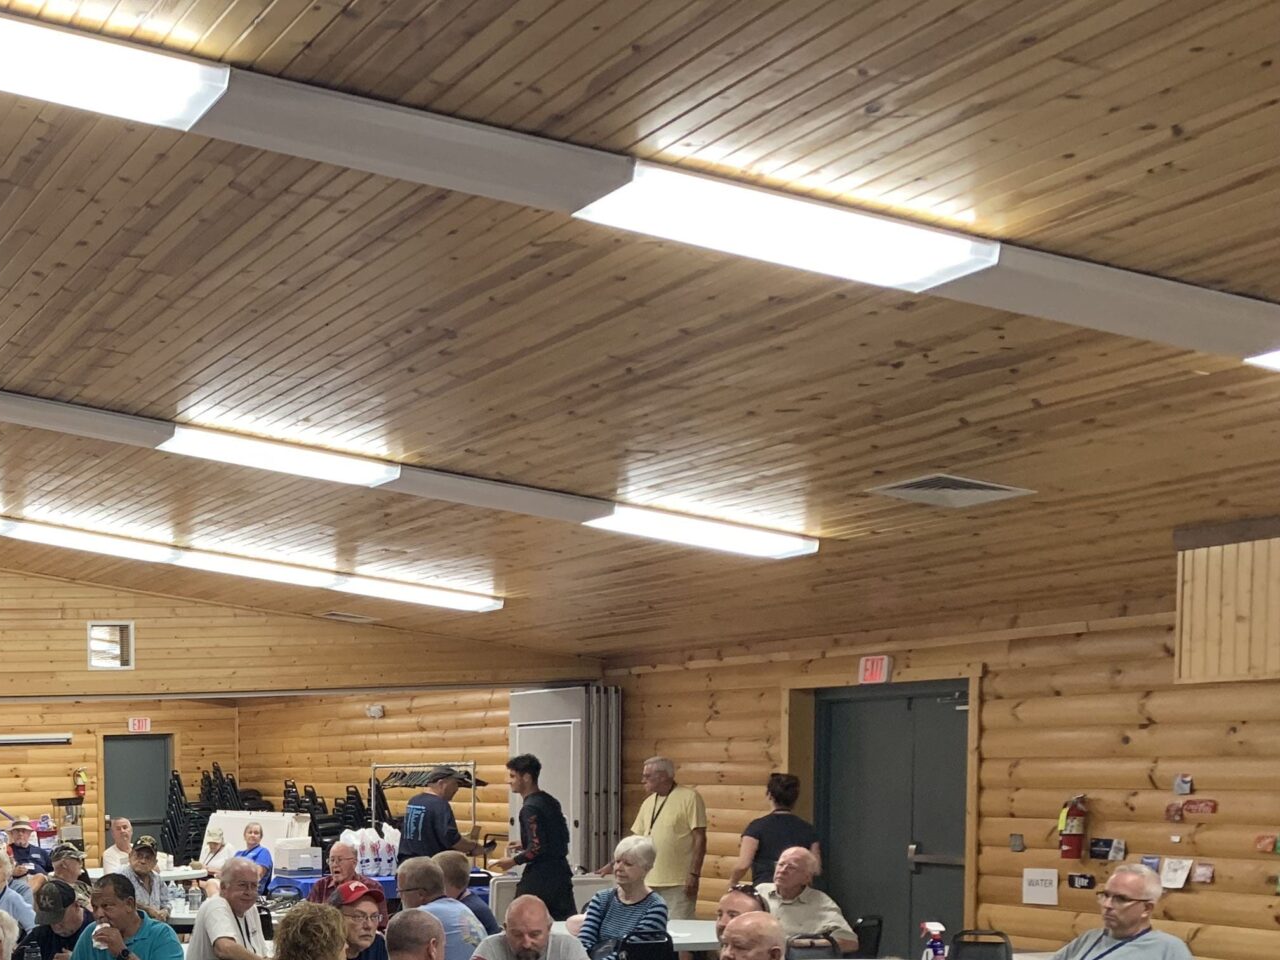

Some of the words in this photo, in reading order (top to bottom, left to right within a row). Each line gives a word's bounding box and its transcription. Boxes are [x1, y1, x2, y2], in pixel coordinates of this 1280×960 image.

[864, 657, 884, 681] EXIT
[132, 718, 148, 731] EXIT
[1027, 878, 1054, 888] WATER
